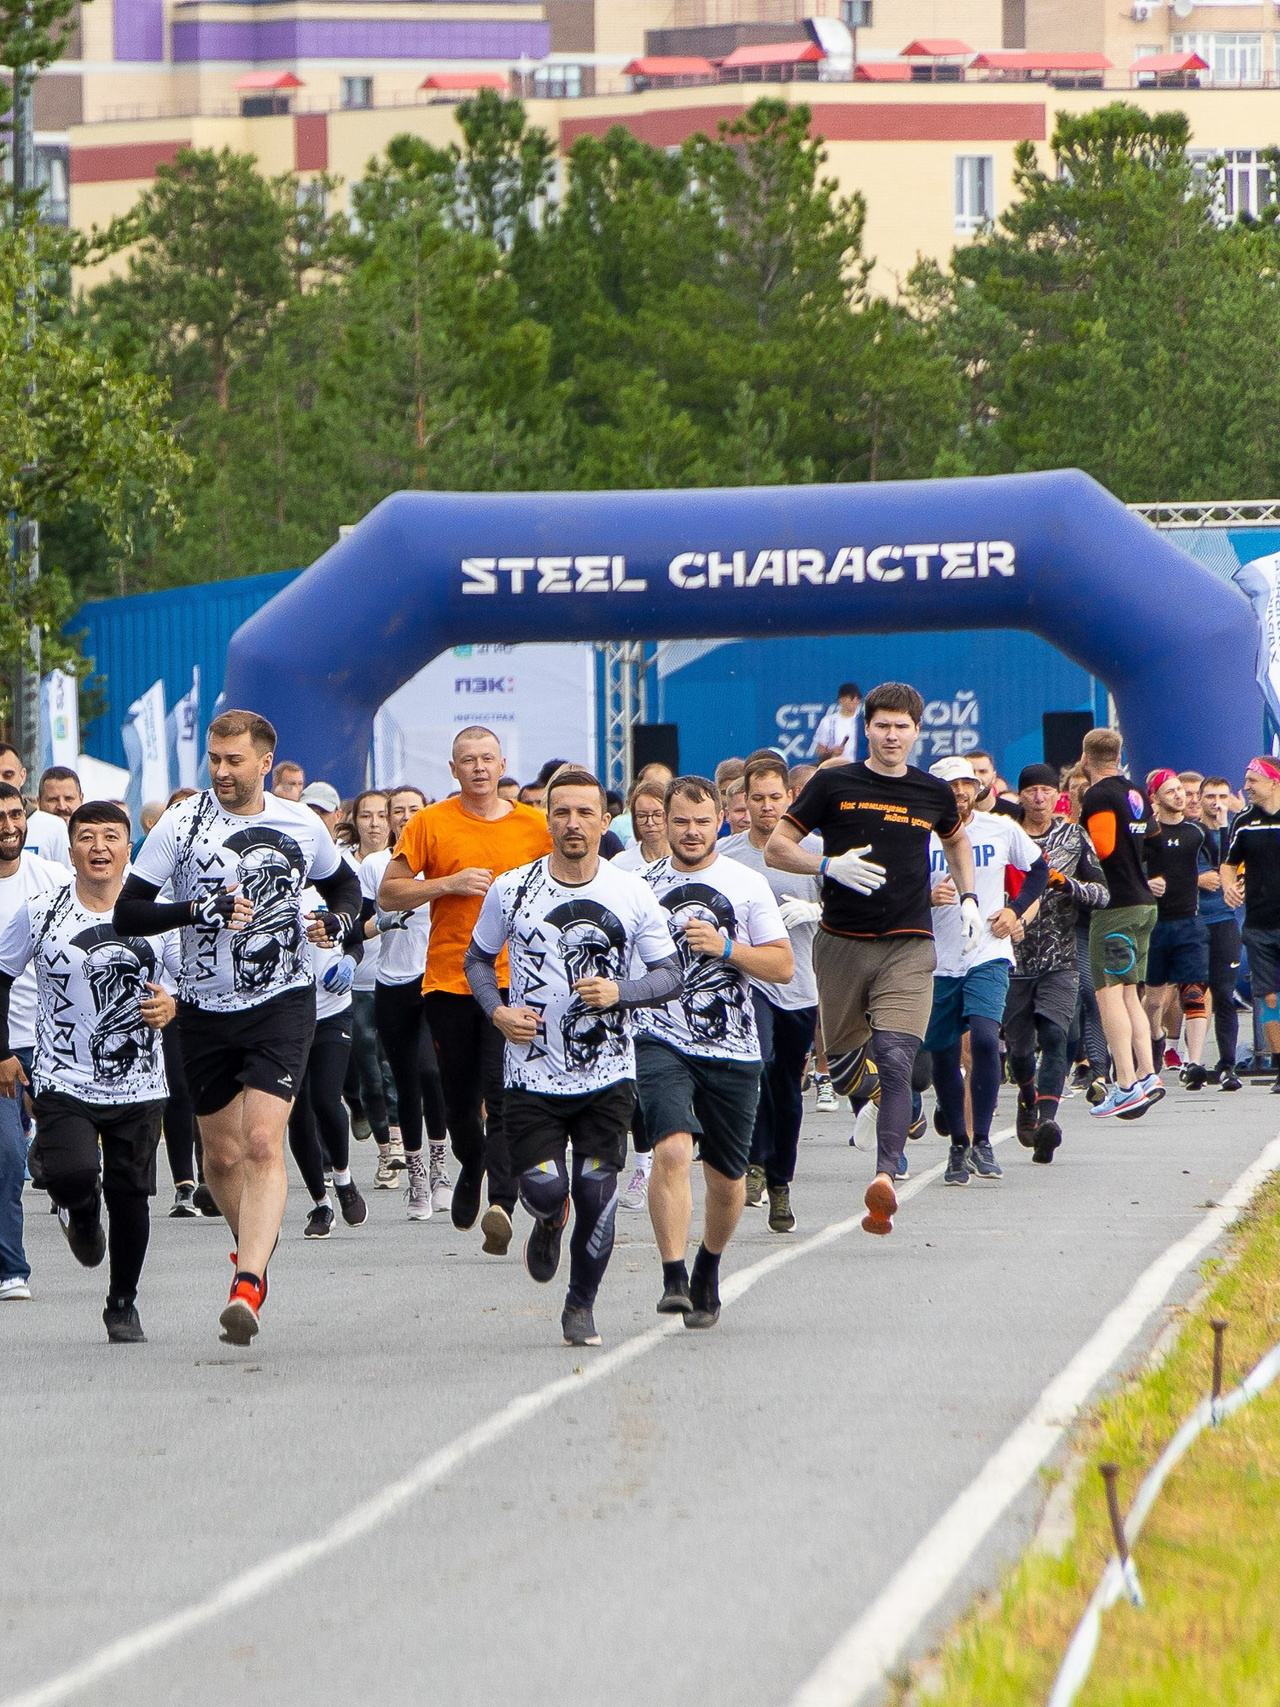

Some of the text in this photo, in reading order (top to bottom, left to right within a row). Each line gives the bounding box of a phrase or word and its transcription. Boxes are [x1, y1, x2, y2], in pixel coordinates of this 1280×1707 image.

[461, 541, 1016, 595] STEEL CHARACTER
[195, 852, 226, 981] SPRTA
[42, 949, 79, 1074] SPARTA
